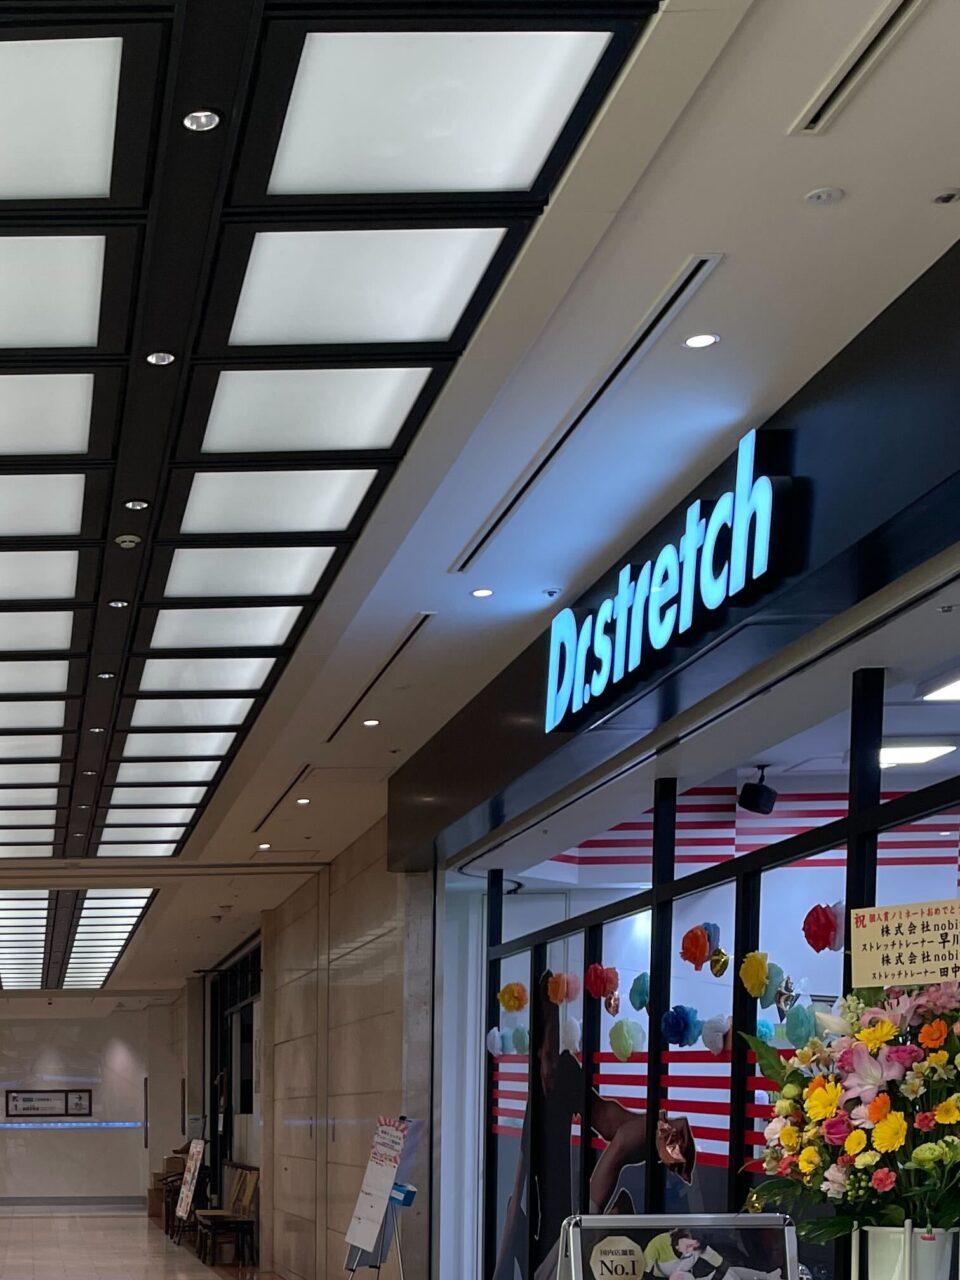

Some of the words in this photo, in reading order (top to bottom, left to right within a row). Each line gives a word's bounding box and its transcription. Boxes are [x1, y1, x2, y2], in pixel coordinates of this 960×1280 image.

[545, 428, 773, 734] Dr.stretch
[854, 913, 867, 929] 祝
[869, 905, 960, 922] 個人賞ノミネートおめでと
[881, 919, 960, 937] 株式会社nobi
[861, 938, 935, 953] ストレッチトレーナー
[600, 1260, 638, 1276] No.1
